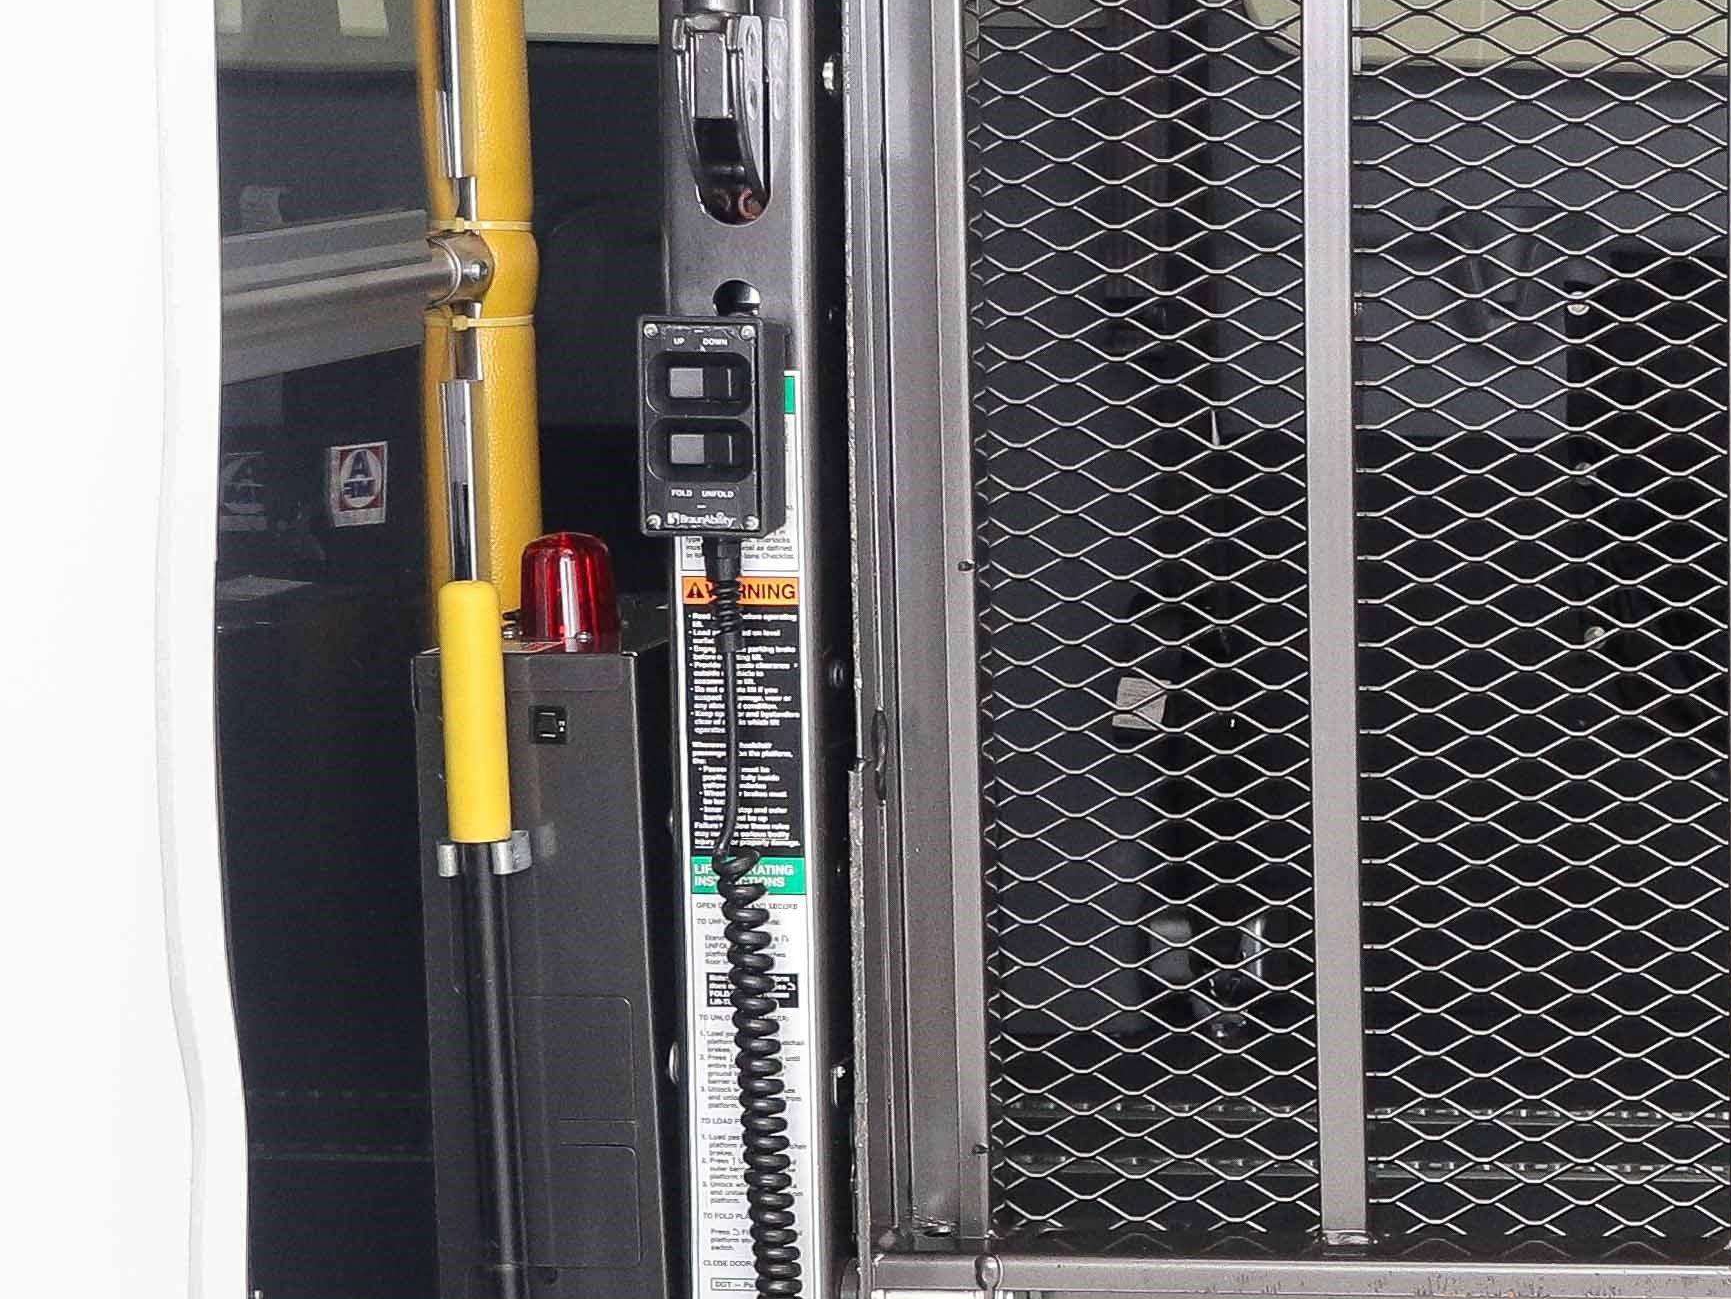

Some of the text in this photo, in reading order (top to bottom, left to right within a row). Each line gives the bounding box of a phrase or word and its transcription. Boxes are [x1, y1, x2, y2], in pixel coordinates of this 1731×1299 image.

[671, 489, 734, 498] FOLD UNFOLD
[680, 512, 735, 526] BraunAbility
[705, 584, 795, 599] WRNING
